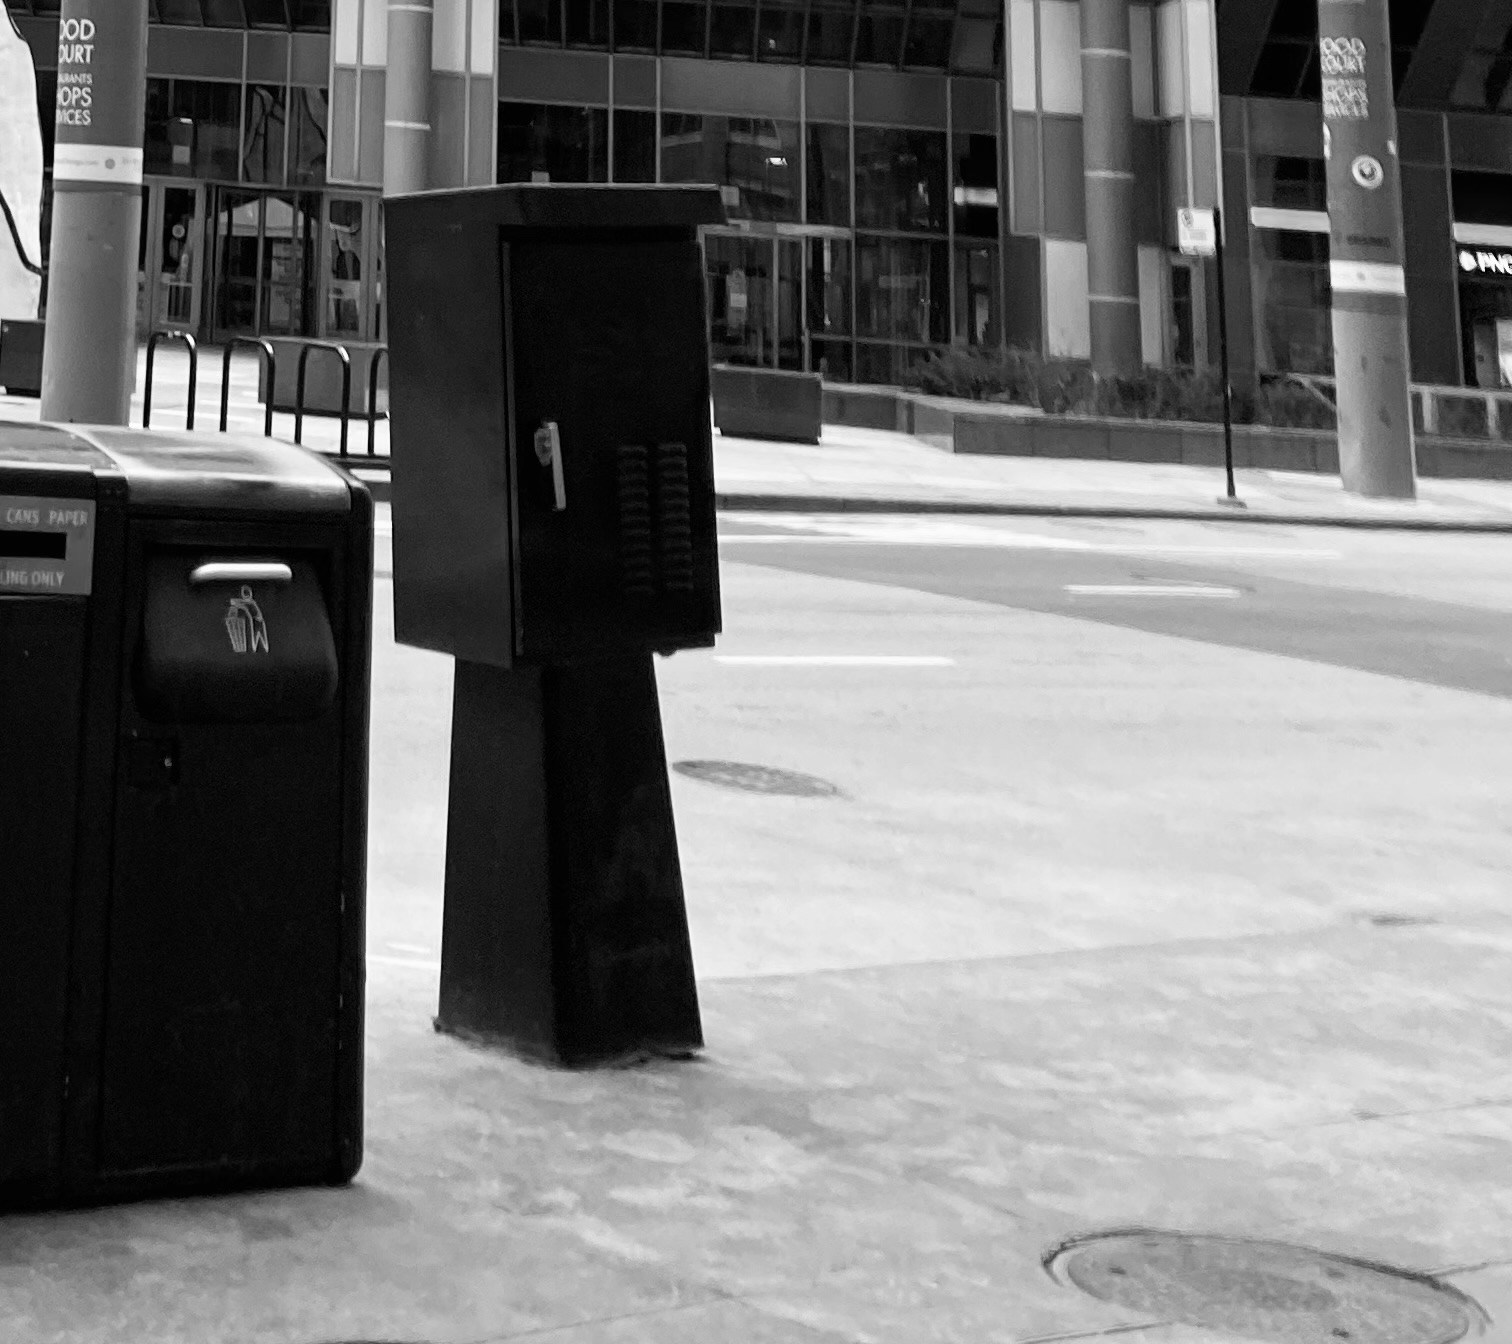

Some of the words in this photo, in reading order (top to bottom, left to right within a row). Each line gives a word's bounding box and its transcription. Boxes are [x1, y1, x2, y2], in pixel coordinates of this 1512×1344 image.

[58, 44, 95, 64] OURT
[6, 508, 40, 525] CANS
[49, 509, 89, 527] PAPER
[31, 570, 65, 587] ONLY
